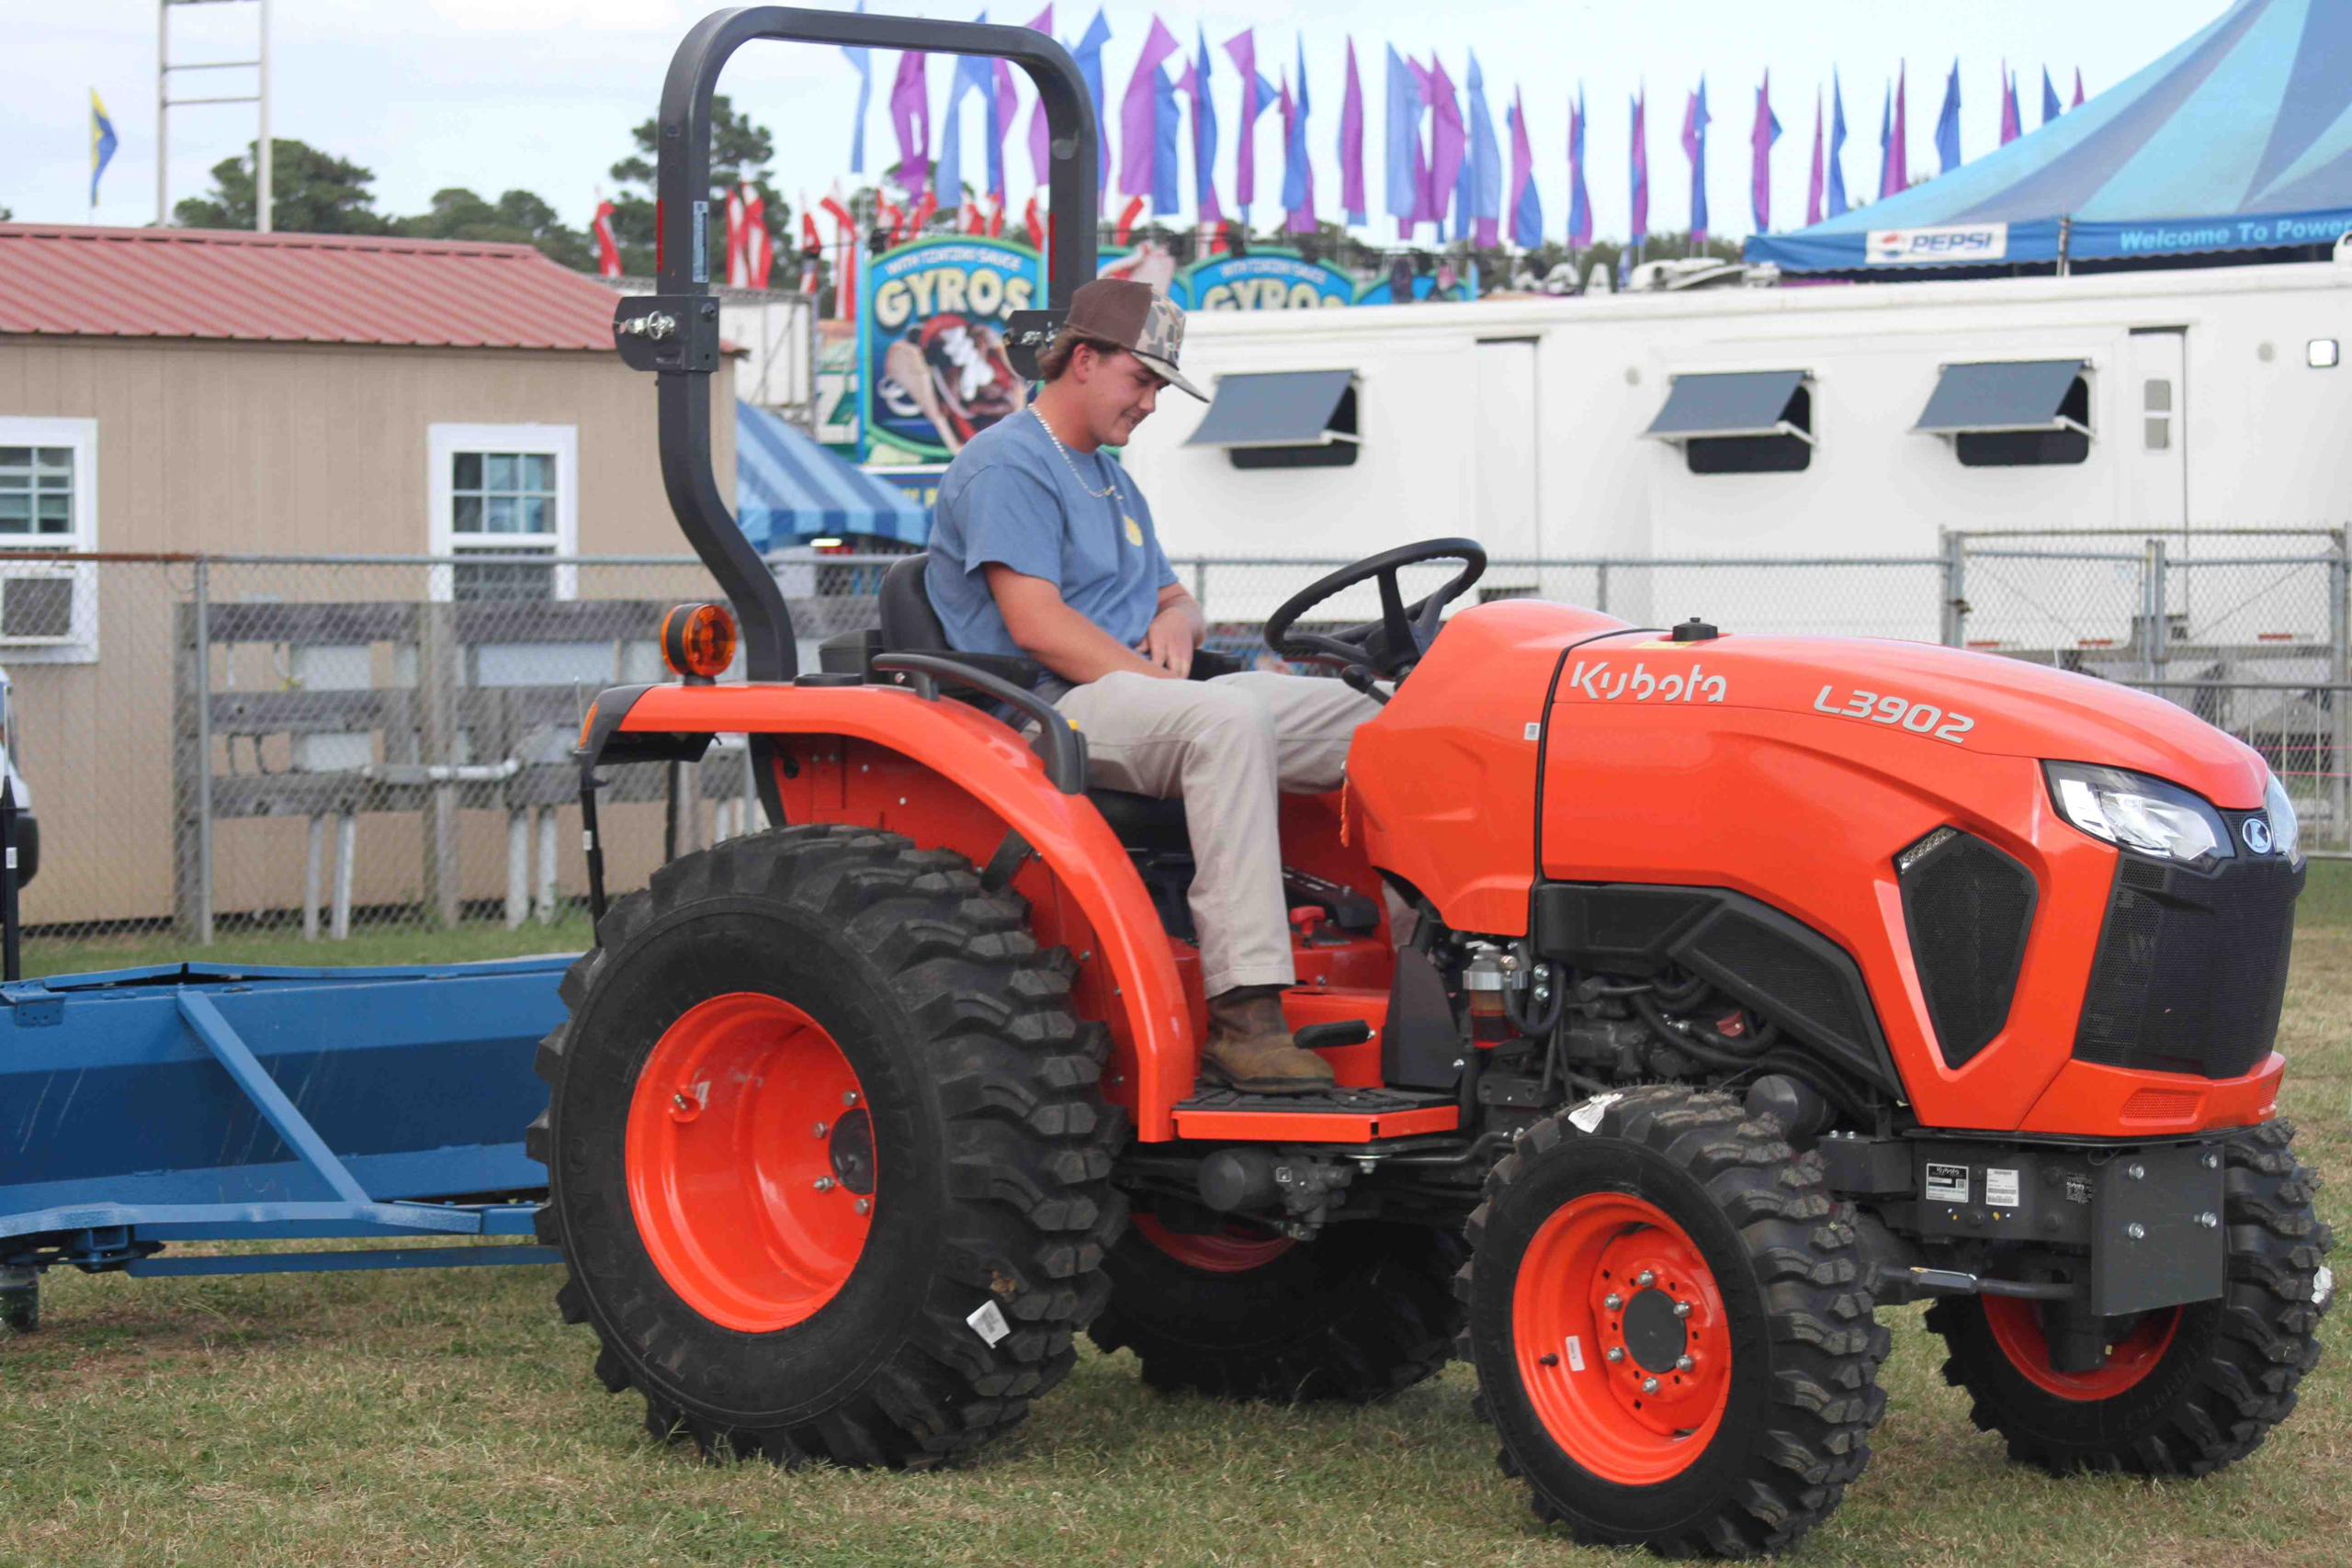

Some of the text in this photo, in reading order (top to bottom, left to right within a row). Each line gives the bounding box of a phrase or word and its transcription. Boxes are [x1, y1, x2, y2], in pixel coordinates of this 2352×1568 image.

[1911, 232, 1992, 253] PEPSI
[2120, 227, 2229, 251] Welcome
[2237, 222, 2267, 242] To
[876, 266, 1033, 327] GYROS
[1570, 660, 1726, 703] Kubota
[1814, 685, 1974, 744] L3902
